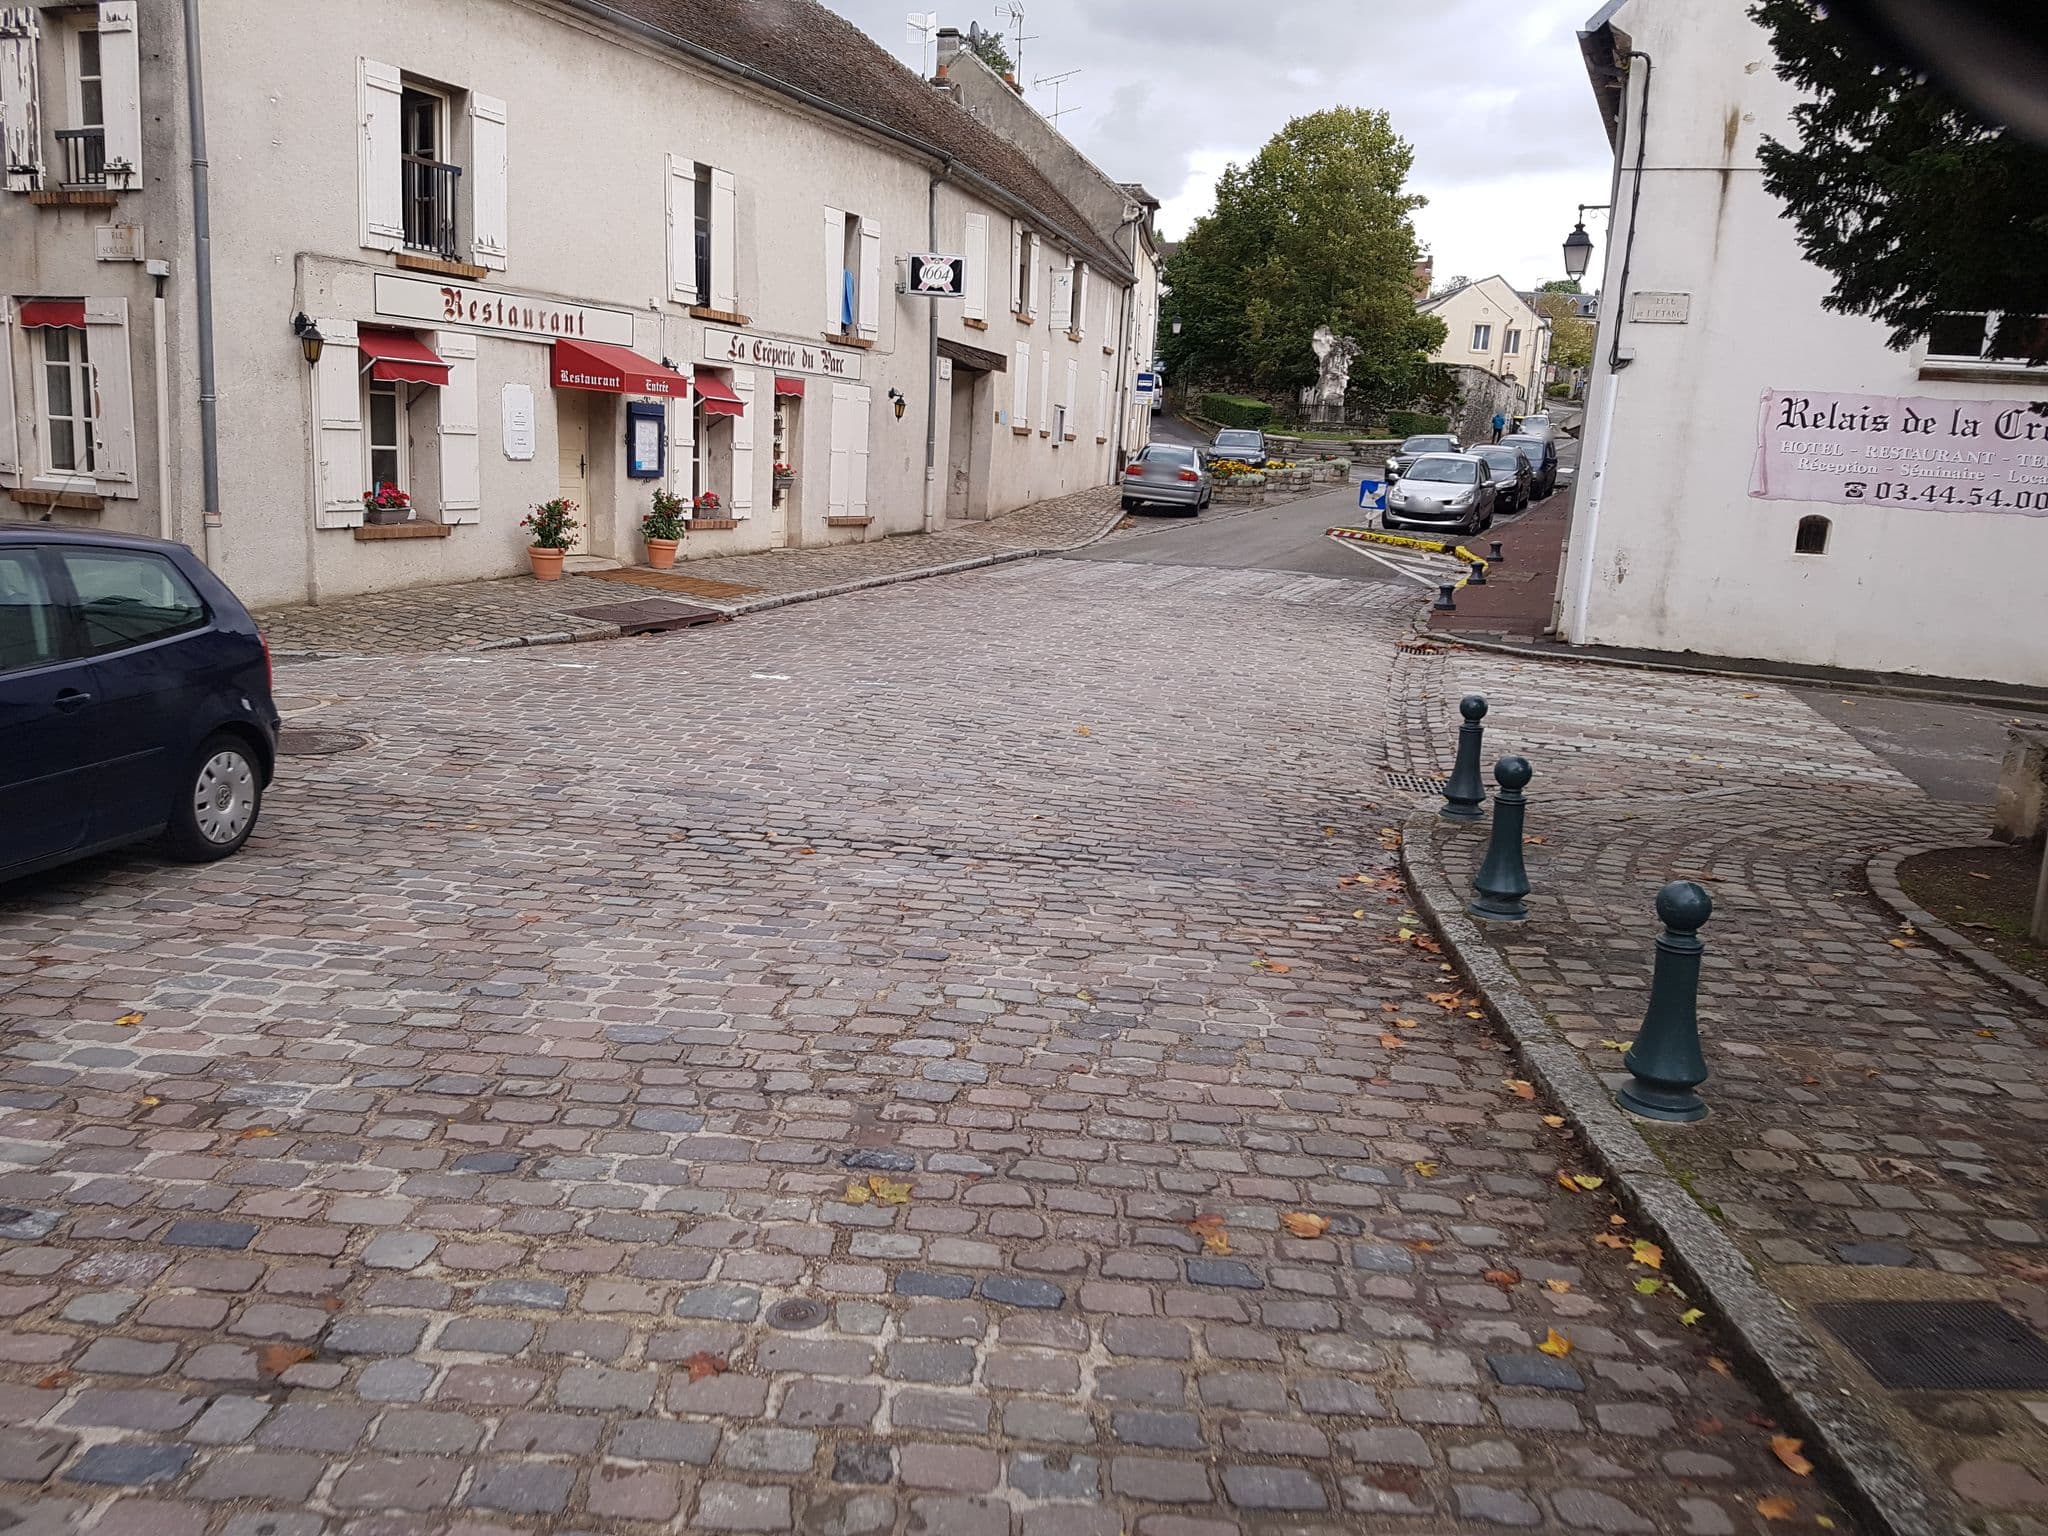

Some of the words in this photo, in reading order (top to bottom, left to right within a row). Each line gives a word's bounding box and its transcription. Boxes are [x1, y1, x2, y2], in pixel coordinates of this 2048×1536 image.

[922, 265, 951, 281] 1664
[440, 286, 585, 336] Restaurant
[727, 334, 745, 361] La
[753, 340, 796, 368] Crêperie
[802, 348, 814, 370] du
[821, 349, 845, 375] Parc
[560, 369, 620, 388] Restaurant
[645, 379, 669, 393] Entrée
[1776, 397, 1890, 432] Relais
[1901, 406, 1937, 435] de
[1948, 407, 1982, 437] la
[1780, 440, 1844, 457] HOTEL
[1865, 445, 1997, 466] RESTAURANT
[1797, 457, 1880, 476] Réception
[1900, 463, 1986, 481] Séminaire
